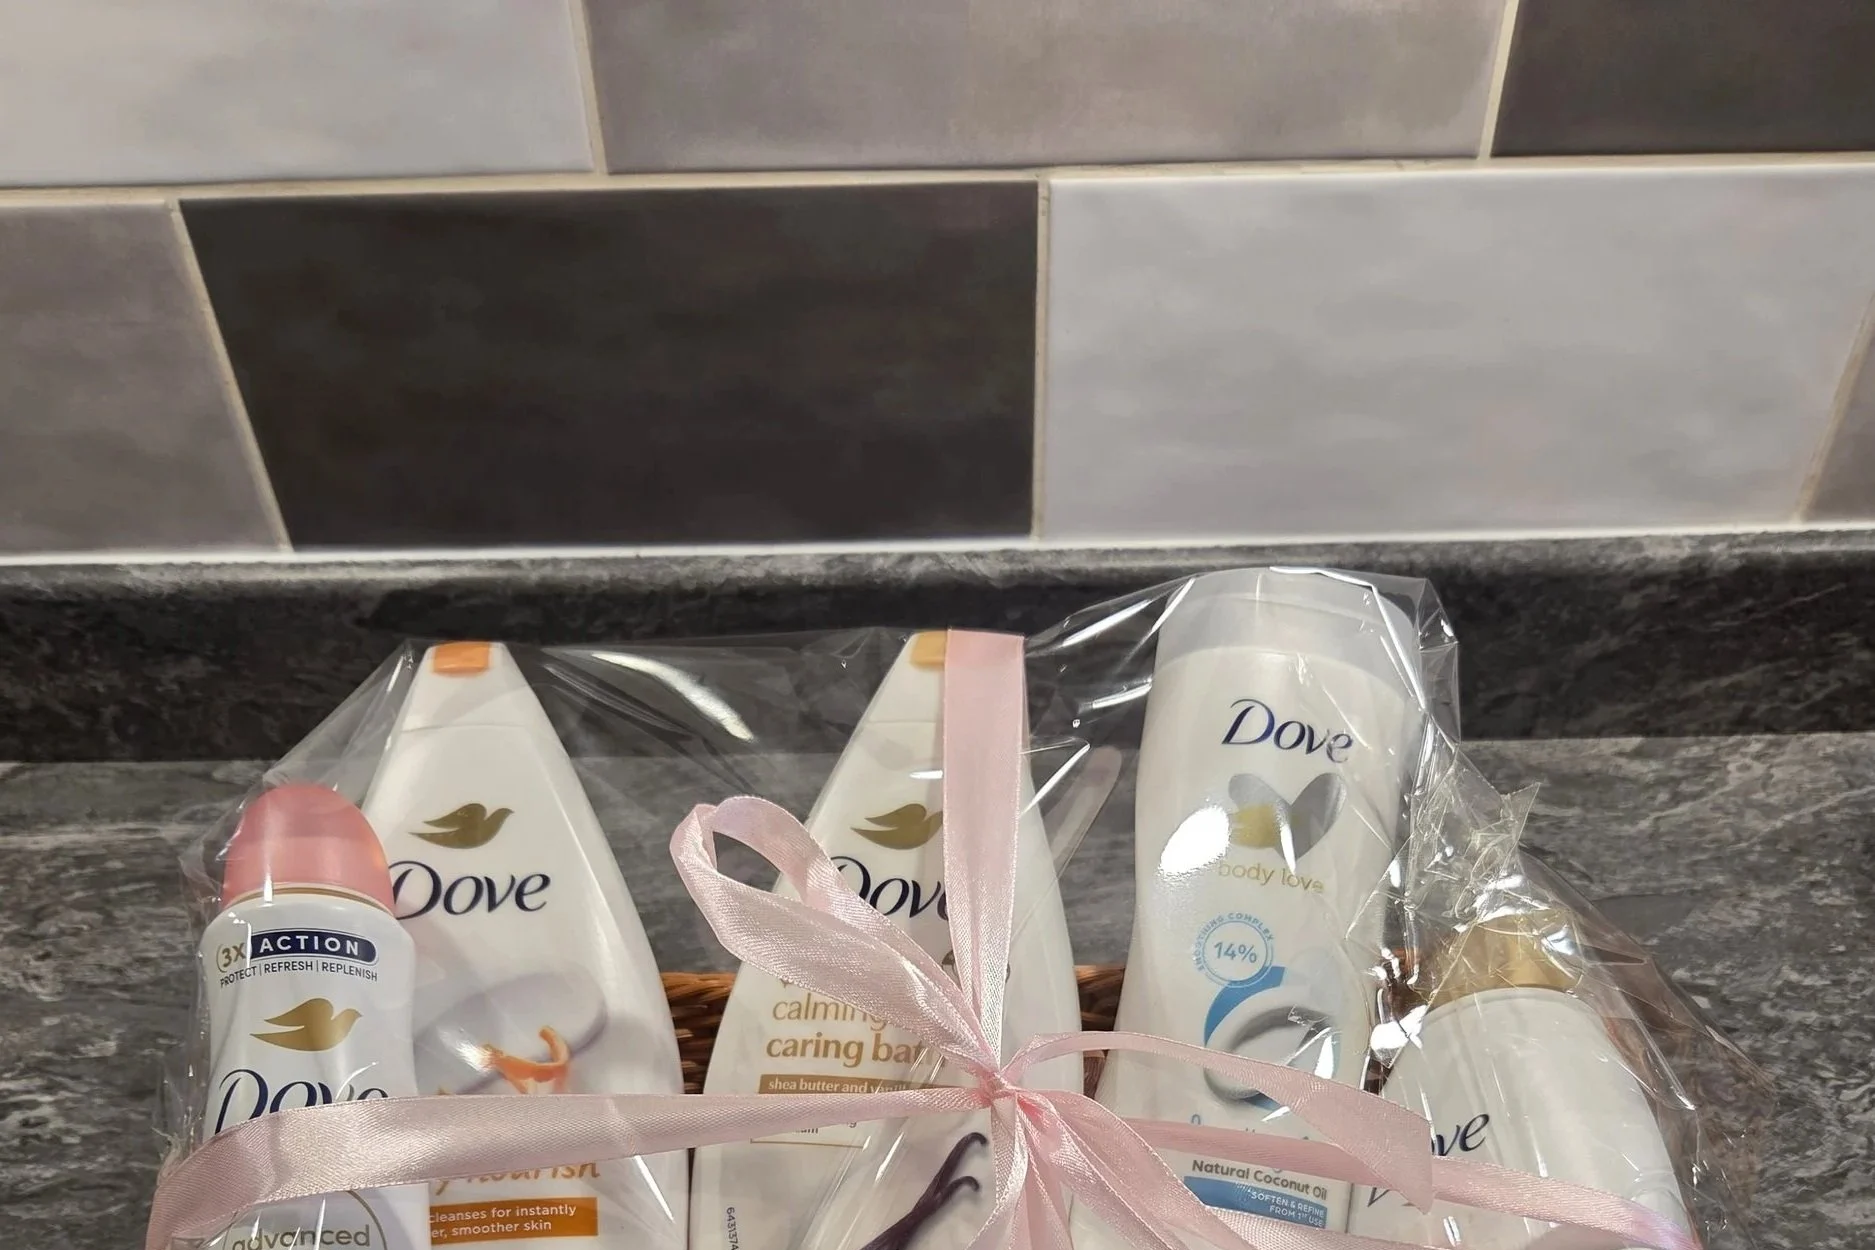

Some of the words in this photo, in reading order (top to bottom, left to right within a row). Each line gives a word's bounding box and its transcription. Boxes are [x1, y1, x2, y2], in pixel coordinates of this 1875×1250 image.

[1221, 698, 1354, 763] Dove
[388, 859, 551, 921] Dove
[829, 855, 949, 920] Dov
[1217, 860, 1275, 886] body
[1281, 867, 1325, 894] love
[1227, 912, 1274, 941] COMPLEX
[221, 942, 246, 968] 3X
[259, 935, 359, 956] ACTION
[1213, 941, 1257, 963] 14%
[220, 965, 257, 988] PROTECT
[264, 960, 313, 974] REFRESH
[321, 961, 378, 982] REPLENISH
[766, 1031, 864, 1068] caring
[768, 1078, 797, 1090] shea
[799, 1078, 839, 1092] butter
[842, 1082, 867, 1093] and
[1191, 1159, 1250, 1180] Natural
[1253, 1170, 1311, 1196] Coconut
[1312, 1185, 1328, 1201] Oil
[490, 1207, 512, 1219] for
[515, 1204, 577, 1217] instantly
[1250, 1190, 1289, 1208] SOFTEN
[1297, 1202, 1325, 1218] REFINE
[1269, 1205, 1296, 1218] FROM
[451, 1222, 519, 1236] smoother
[523, 1219, 552, 1232] skin
